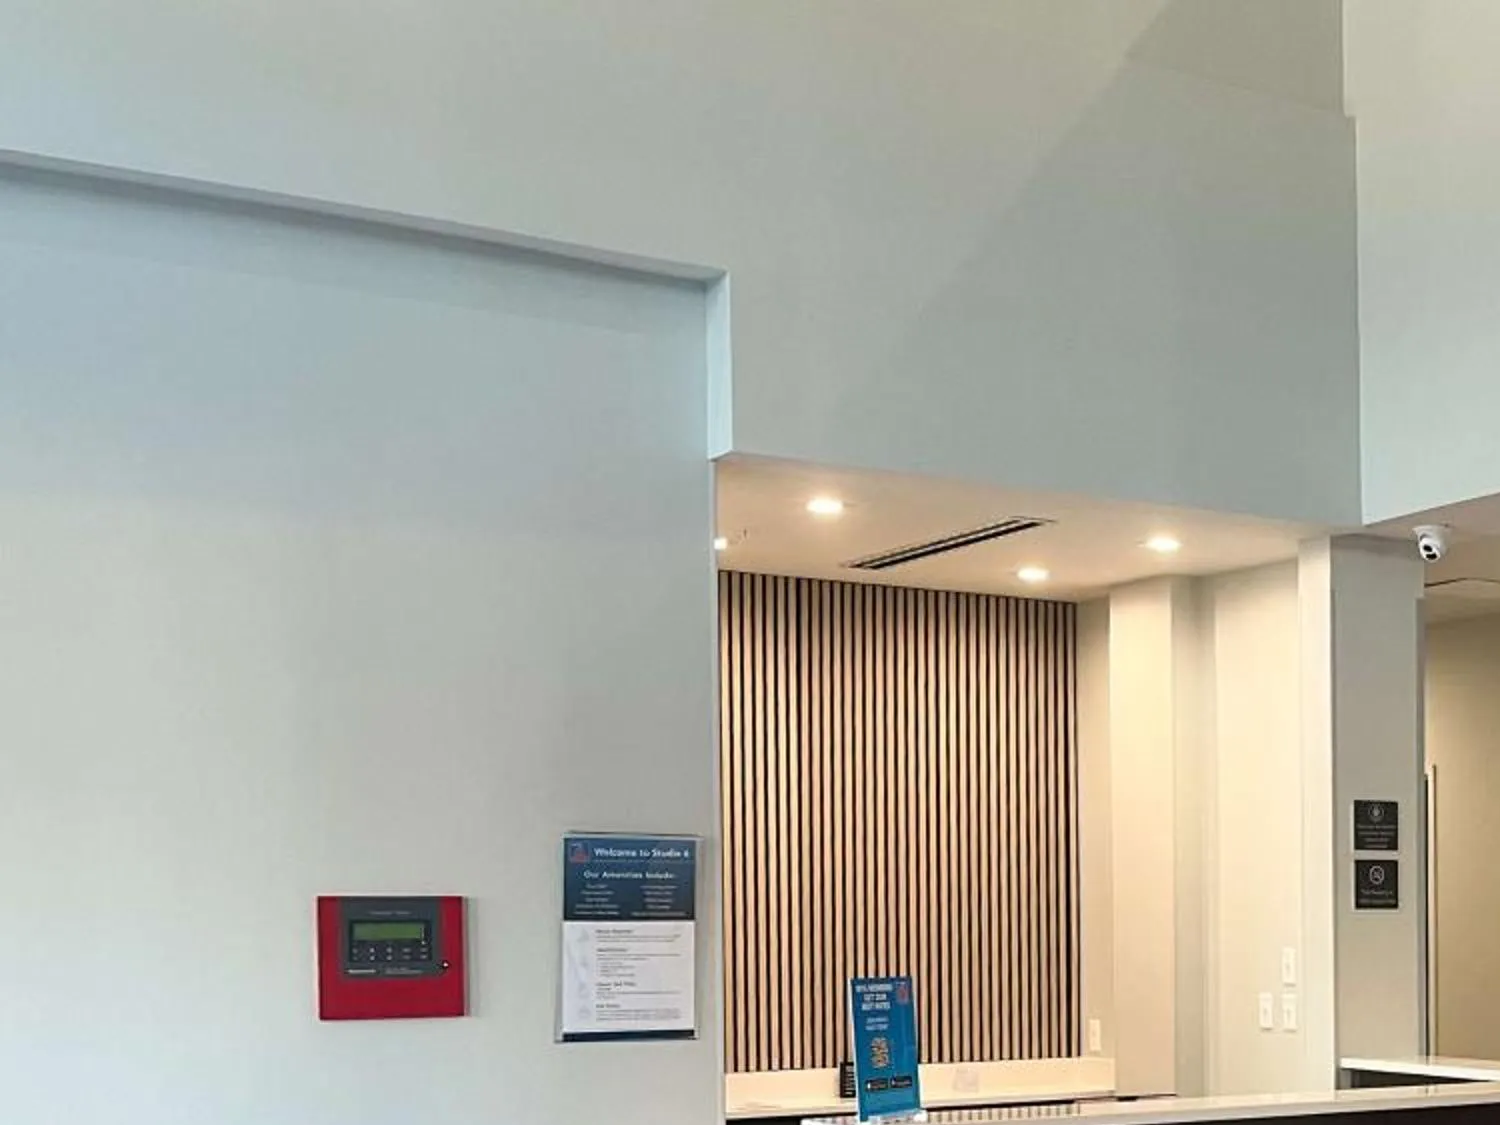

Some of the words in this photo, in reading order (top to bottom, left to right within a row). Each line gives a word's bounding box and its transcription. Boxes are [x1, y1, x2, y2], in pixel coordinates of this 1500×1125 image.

[593, 847, 636, 858] Welcome
[639, 848, 650, 858] to
[651, 847, 682, 858] Studio
